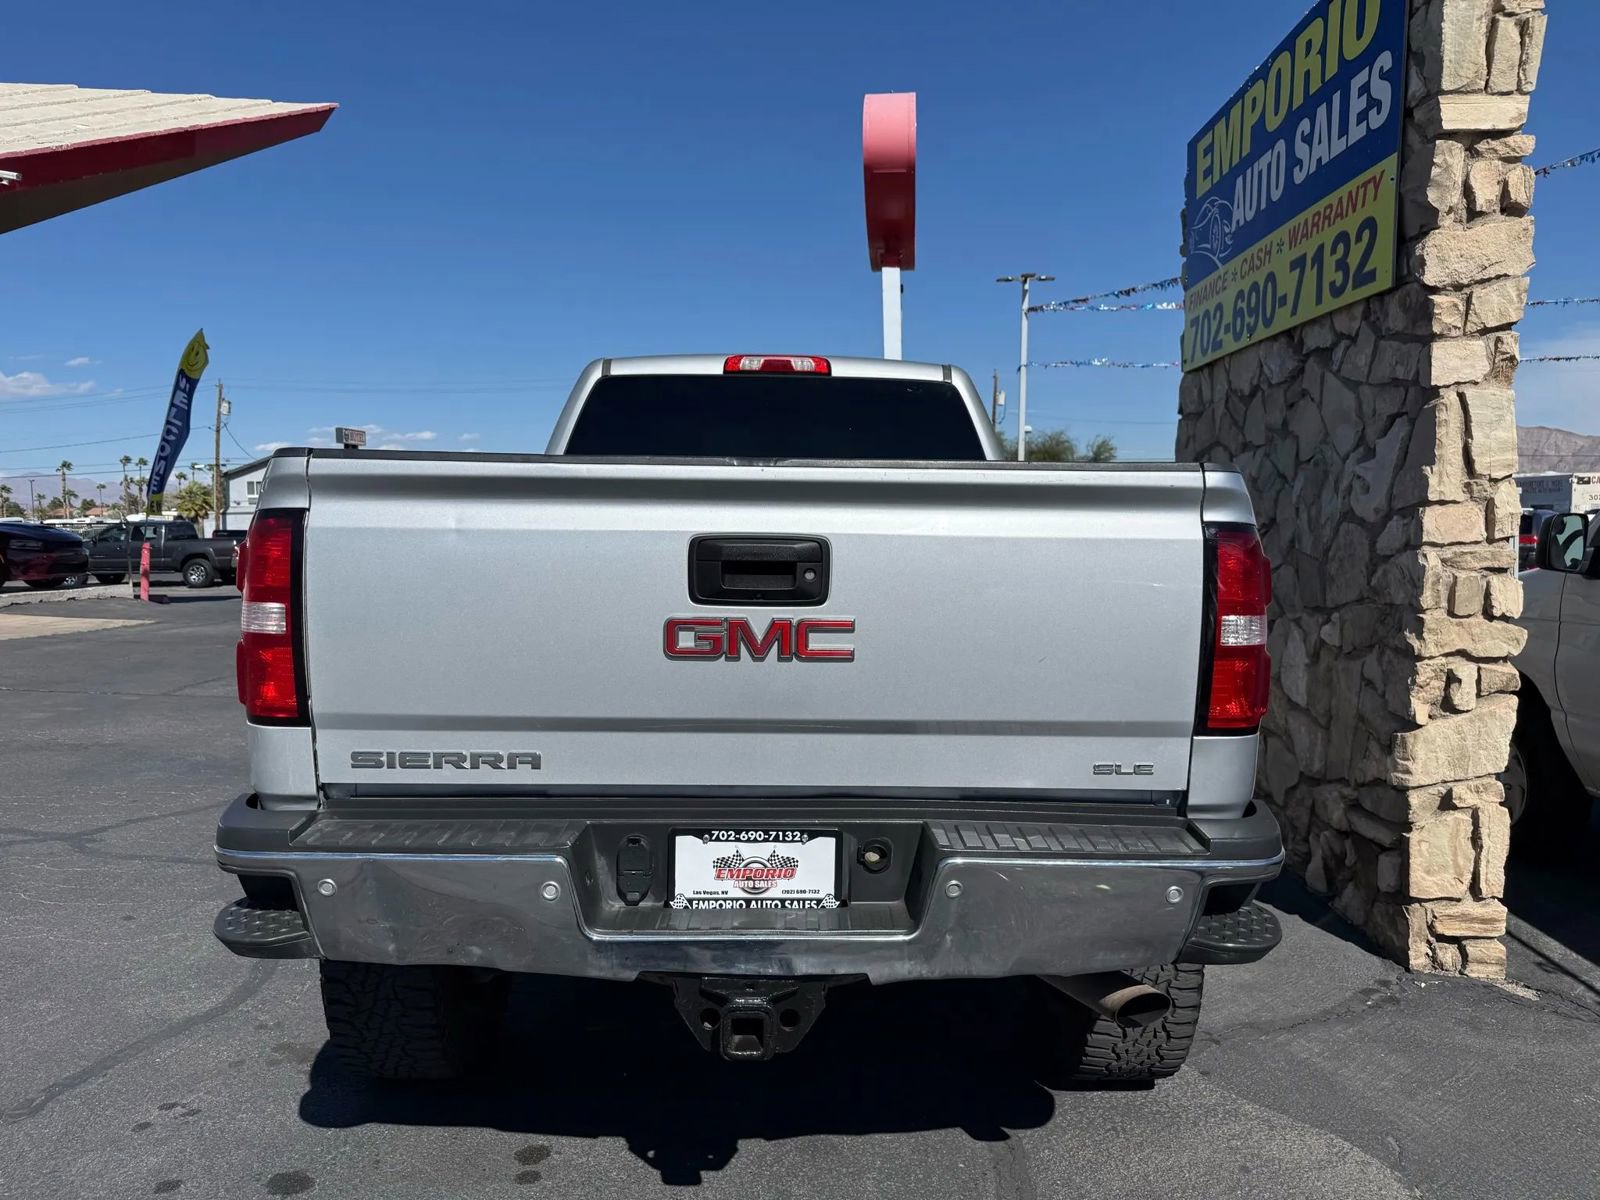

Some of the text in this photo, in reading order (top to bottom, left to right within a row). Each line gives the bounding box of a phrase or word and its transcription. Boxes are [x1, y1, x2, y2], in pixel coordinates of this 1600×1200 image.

[1197, 0, 1381, 199] EMPORIO
[1231, 50, 1393, 233] AUTO SALES
[1188, 168, 1386, 312] FINANCE CASH WARRANTY
[1190, 215, 1378, 364] 702-690-7132
[663, 617, 855, 662] GMC
[351, 751, 541, 770] SIERRA
[1093, 762, 1154, 776] SLE
[711, 830, 801, 841] 702-690-7132
[714, 867, 797, 880] EMPORIO
[733, 880, 778, 888] AUTO SALES
[692, 900, 818, 909] EMPORIO AUTO SALES
